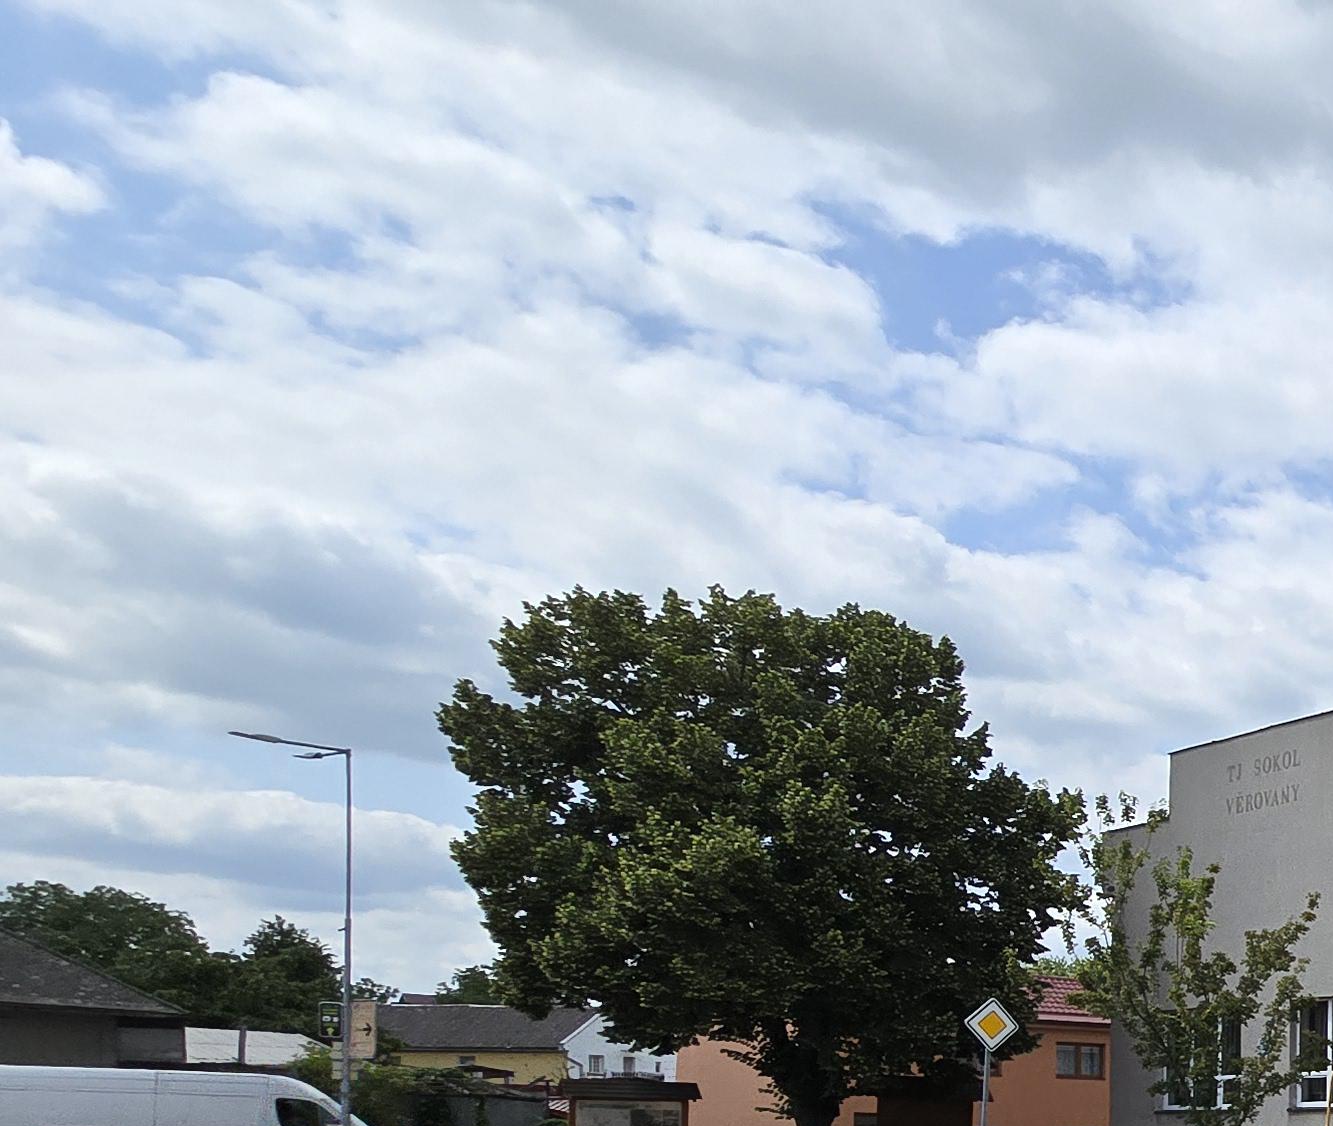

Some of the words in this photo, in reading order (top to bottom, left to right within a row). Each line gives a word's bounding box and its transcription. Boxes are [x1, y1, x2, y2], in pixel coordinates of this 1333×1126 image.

[1227, 763, 1242, 783] TJ
[1253, 749, 1301, 777] SOKOL
[1226, 783, 1300, 815] VĚROVANY
